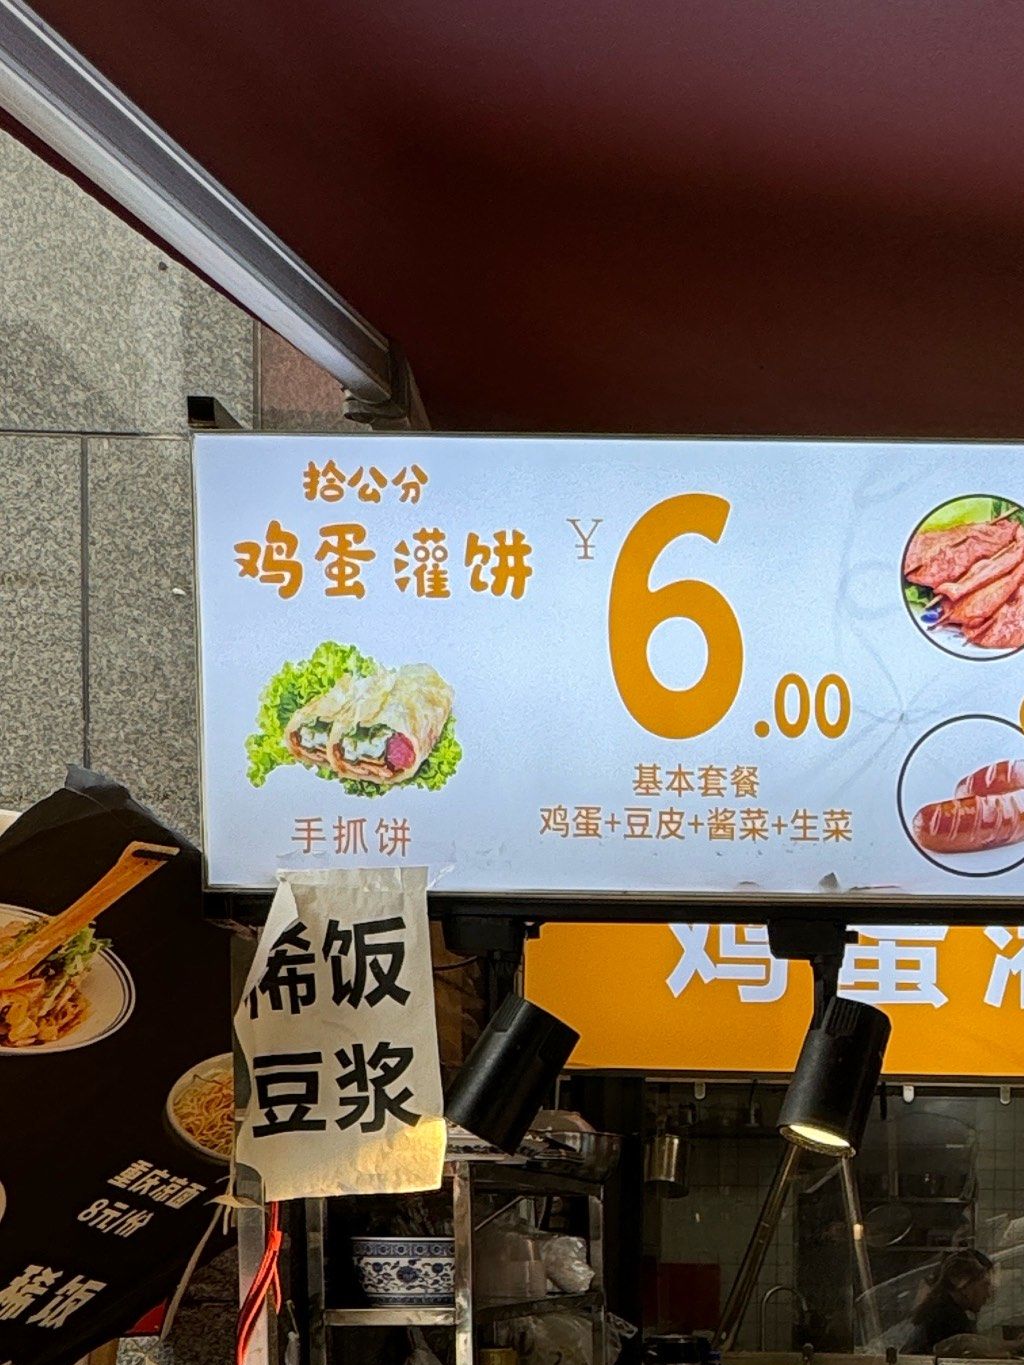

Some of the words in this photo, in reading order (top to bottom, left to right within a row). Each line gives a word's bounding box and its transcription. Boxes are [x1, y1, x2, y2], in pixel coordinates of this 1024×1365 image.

[303, 459, 428, 504] 拾公分
[233, 520, 533, 600] 鸡蛋灌饼
[633, 764, 760, 799] 基本套餐
[291, 817, 413, 858] 手抓饼
[538, 806, 853, 843] 鸡蛋+豆皮+酱菜+生菜
[252, 1041, 421, 1138] 豆浆
[107, 1159, 207, 1210] 重庆凉面
[77, 1198, 154, 1238] 8元/份
